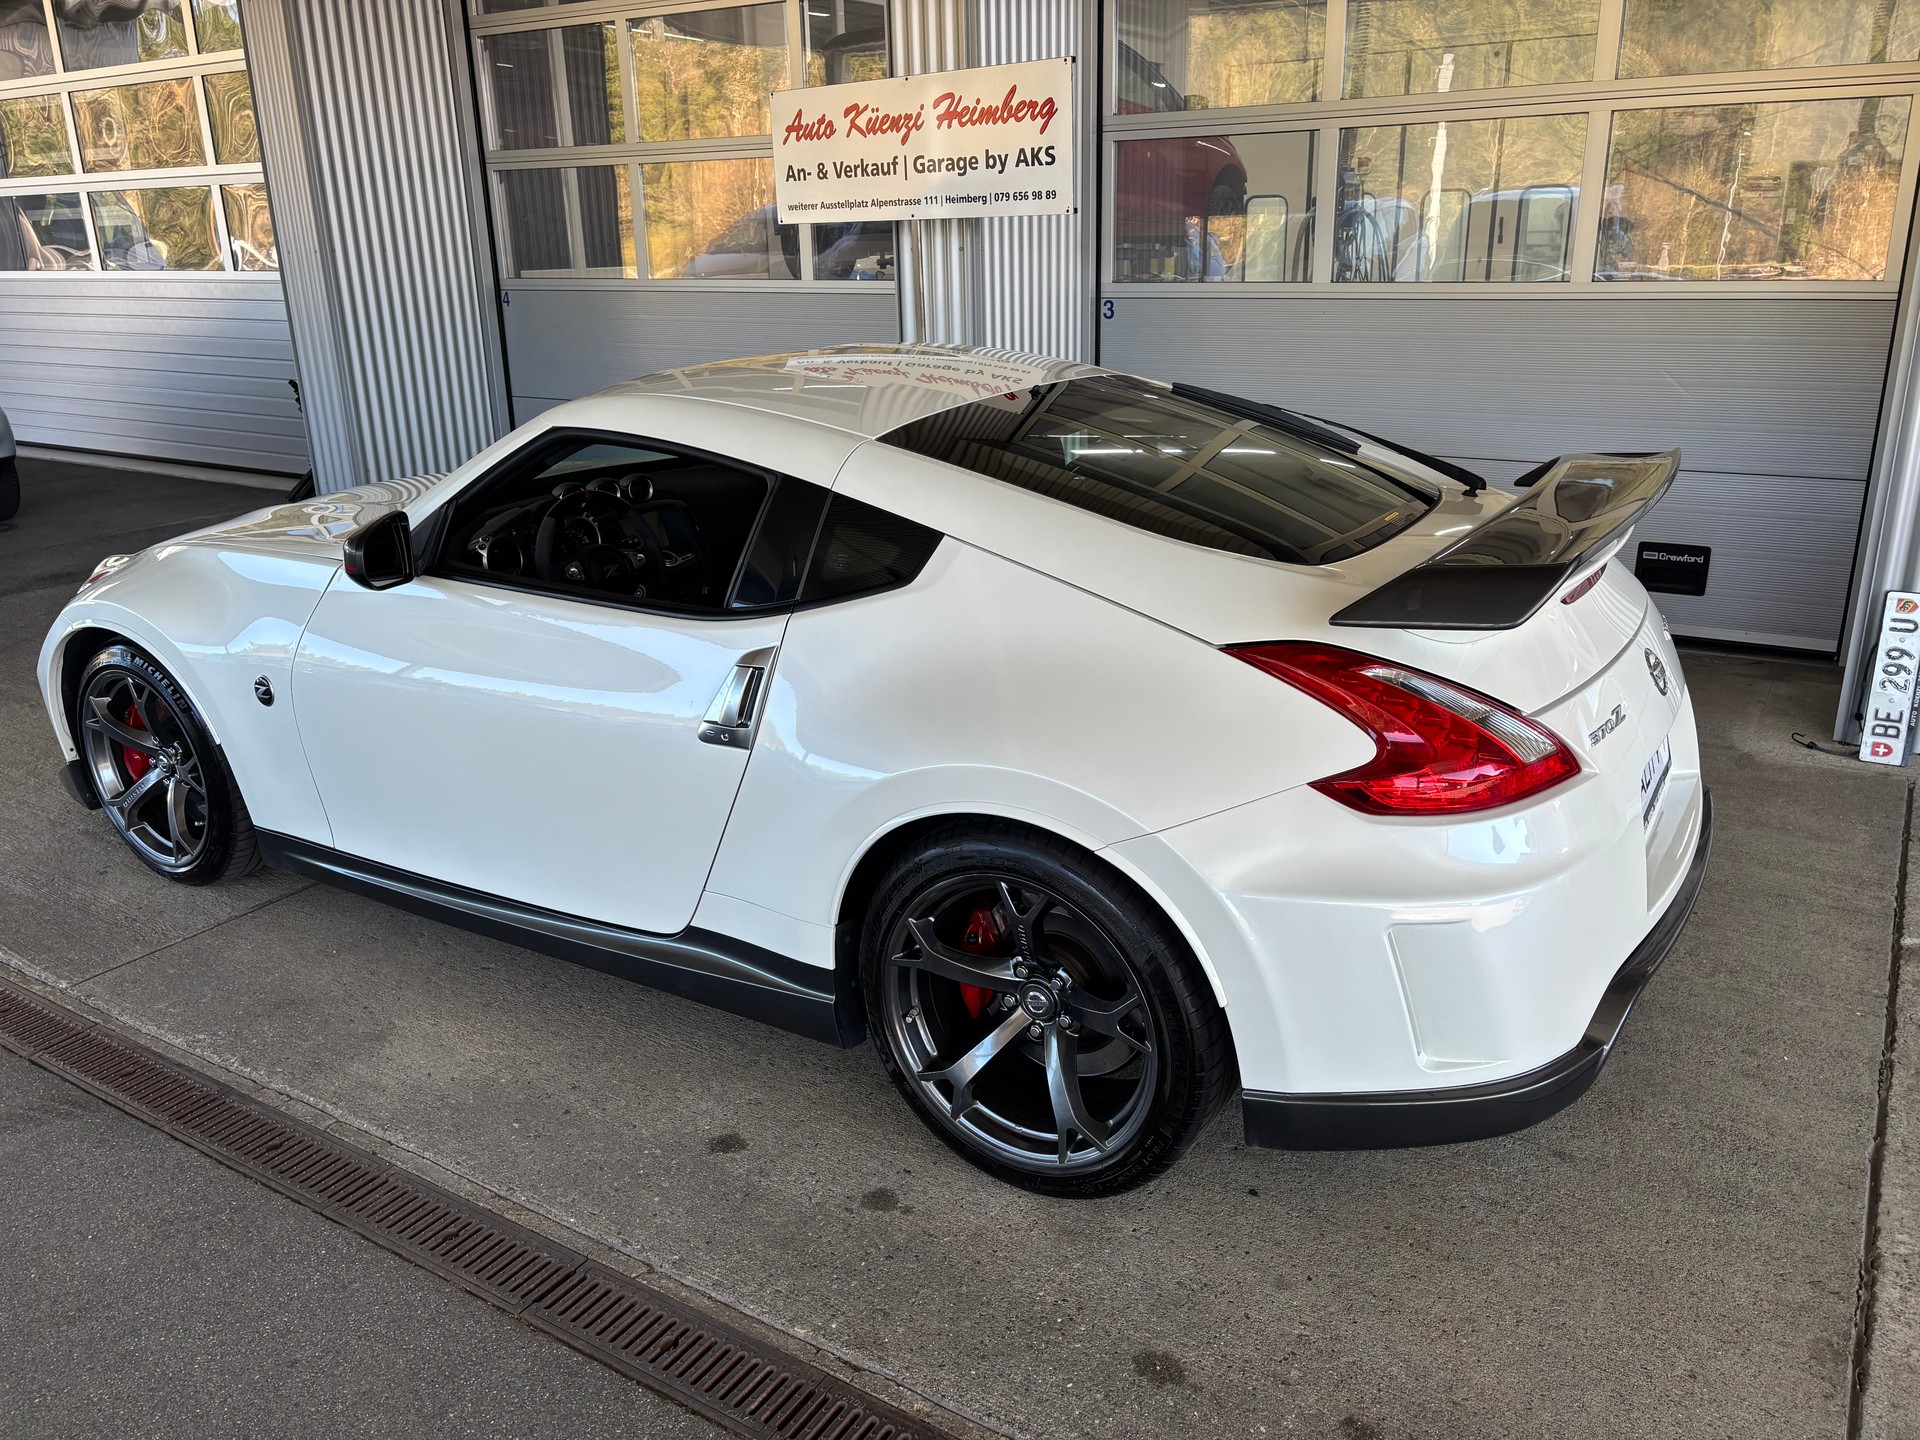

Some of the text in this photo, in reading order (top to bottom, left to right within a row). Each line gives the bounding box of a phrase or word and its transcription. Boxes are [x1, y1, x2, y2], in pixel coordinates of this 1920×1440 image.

[782, 84, 1058, 146] Auto Küenzi Heimberg
[785, 164, 812, 182] An-
[817, 165, 829, 181] &
[833, 155, 899, 180] Verkauf
[912, 153, 979, 178] Garage
[985, 149, 1009, 175] by
[1015, 145, 1056, 168] AKS
[787, 202, 819, 212] weiterer
[820, 199, 869, 211] Ausstellplatz
[870, 197, 922, 210] Alpenstrasse
[924, 195, 938, 206] 111
[945, 193, 988, 206] Heimberg
[994, 191, 1011, 203] 079
[1012, 190, 1029, 201] 656
[1031, 190, 1043, 200] 98
[1045, 189, 1057, 200] 89
[502, 291, 511, 307] 4
[1103, 299, 1115, 320] 3
[1659, 552, 1704, 564] Crawford
[133, 656, 189, 710] MICHELIN
[1871, 617, 1919, 739] BE 299 U
[1588, 703, 1626, 747] 370Z
